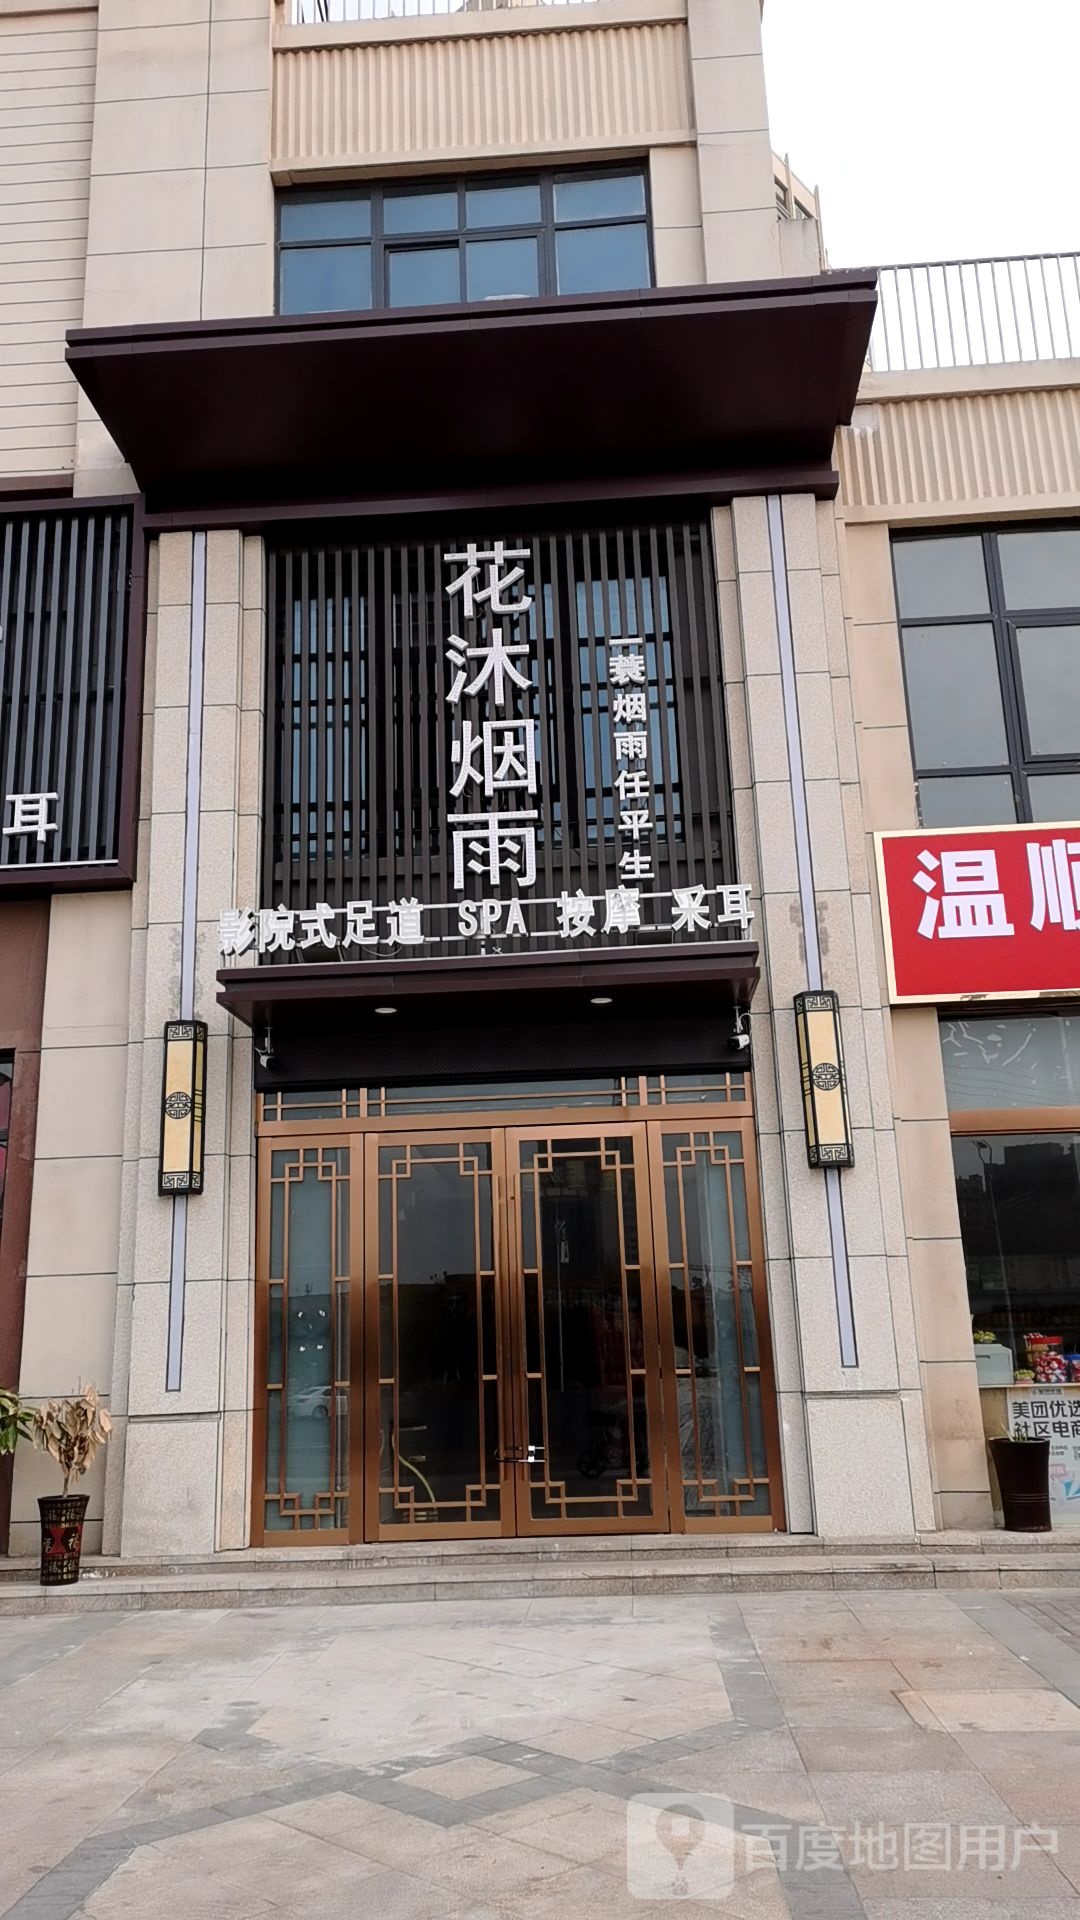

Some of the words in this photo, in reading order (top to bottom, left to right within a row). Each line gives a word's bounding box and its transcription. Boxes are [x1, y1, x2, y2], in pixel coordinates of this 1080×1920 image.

[444, 541, 538, 889] 花沐烟雨
[609, 638, 655, 880] 一蓑烟雨任平生
[2, 792, 58, 843] 耳
[218, 897, 425, 955] 影院式足道
[458, 898, 528, 937] SPA
[557, 885, 642, 938] 按摩
[671, 884, 755, 932] 采耳
[1012, 1400, 1080, 1419] 美团优选
